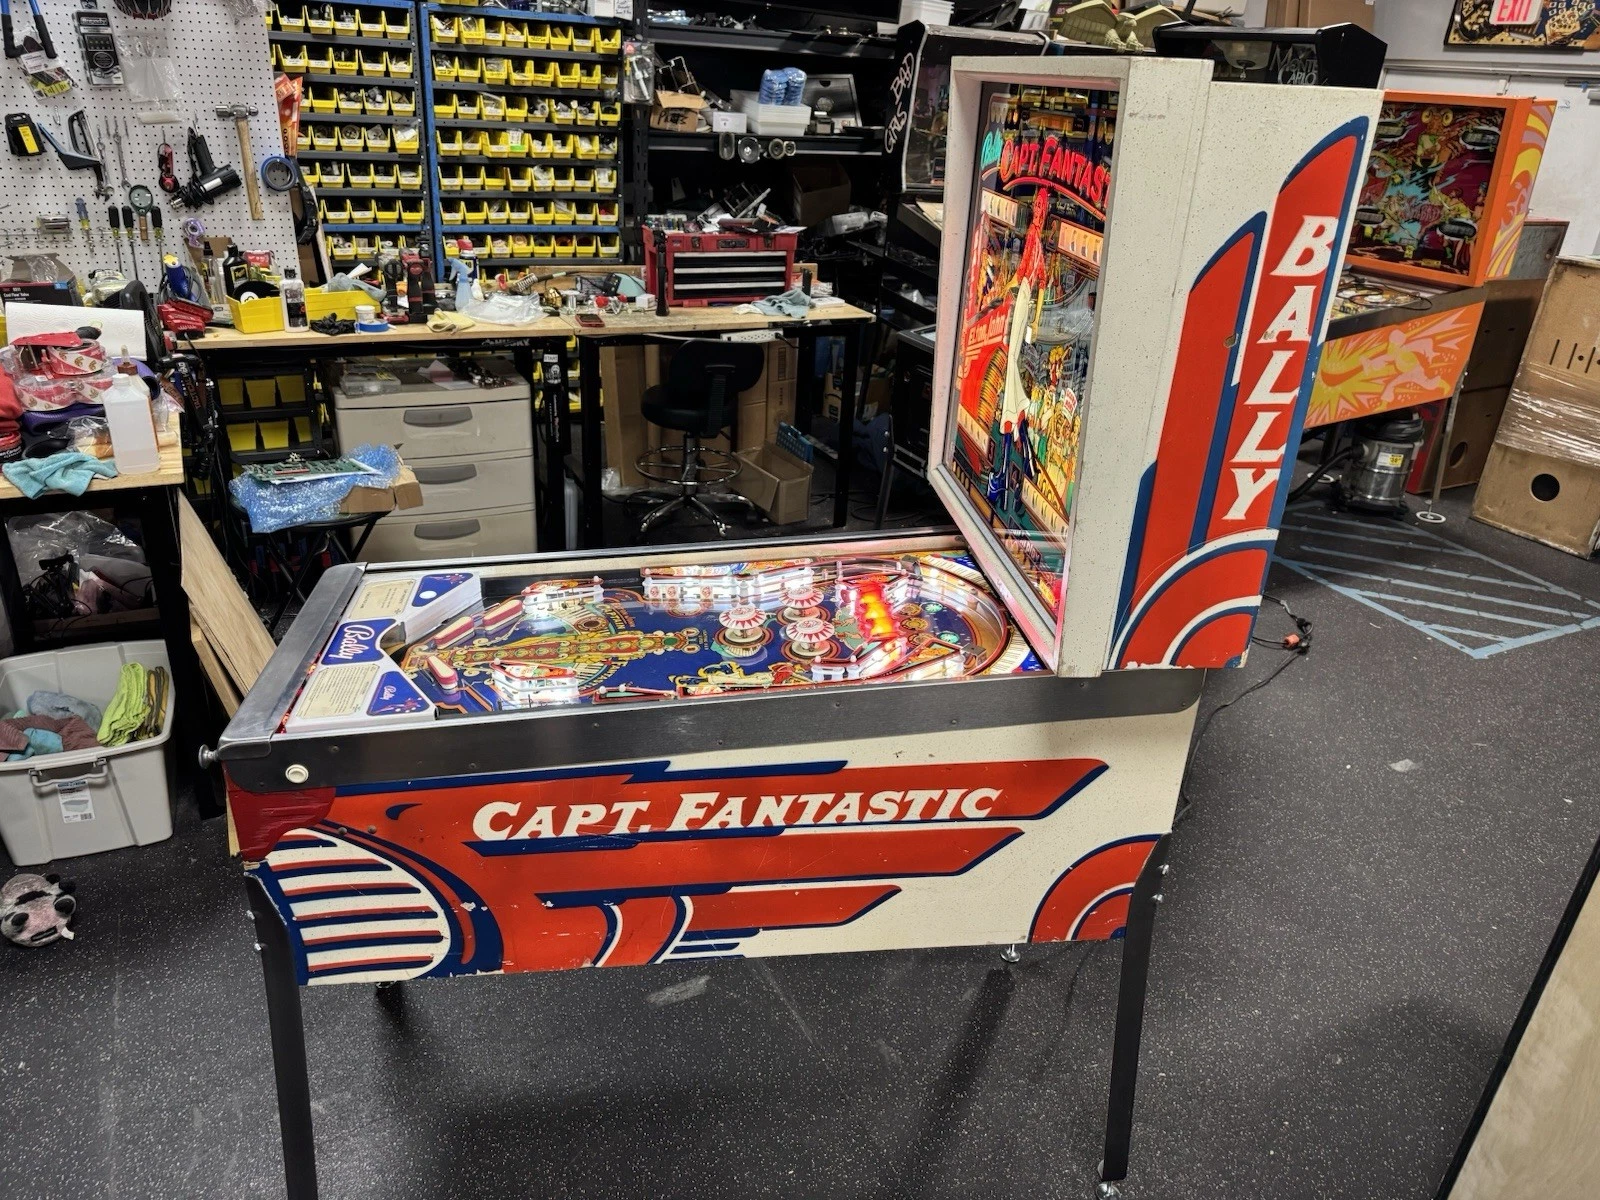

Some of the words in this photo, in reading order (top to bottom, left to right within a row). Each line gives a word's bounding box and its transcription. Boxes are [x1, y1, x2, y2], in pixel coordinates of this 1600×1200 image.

[889, 52, 915, 105] BAD
[1000, 137, 1040, 182] CAPT.
[1222, 215, 1338, 520] BALLY
[328, 624, 376, 660] Bally
[473, 799, 652, 841] CAPT.
[667, 788, 1004, 830] FANTASTIC
